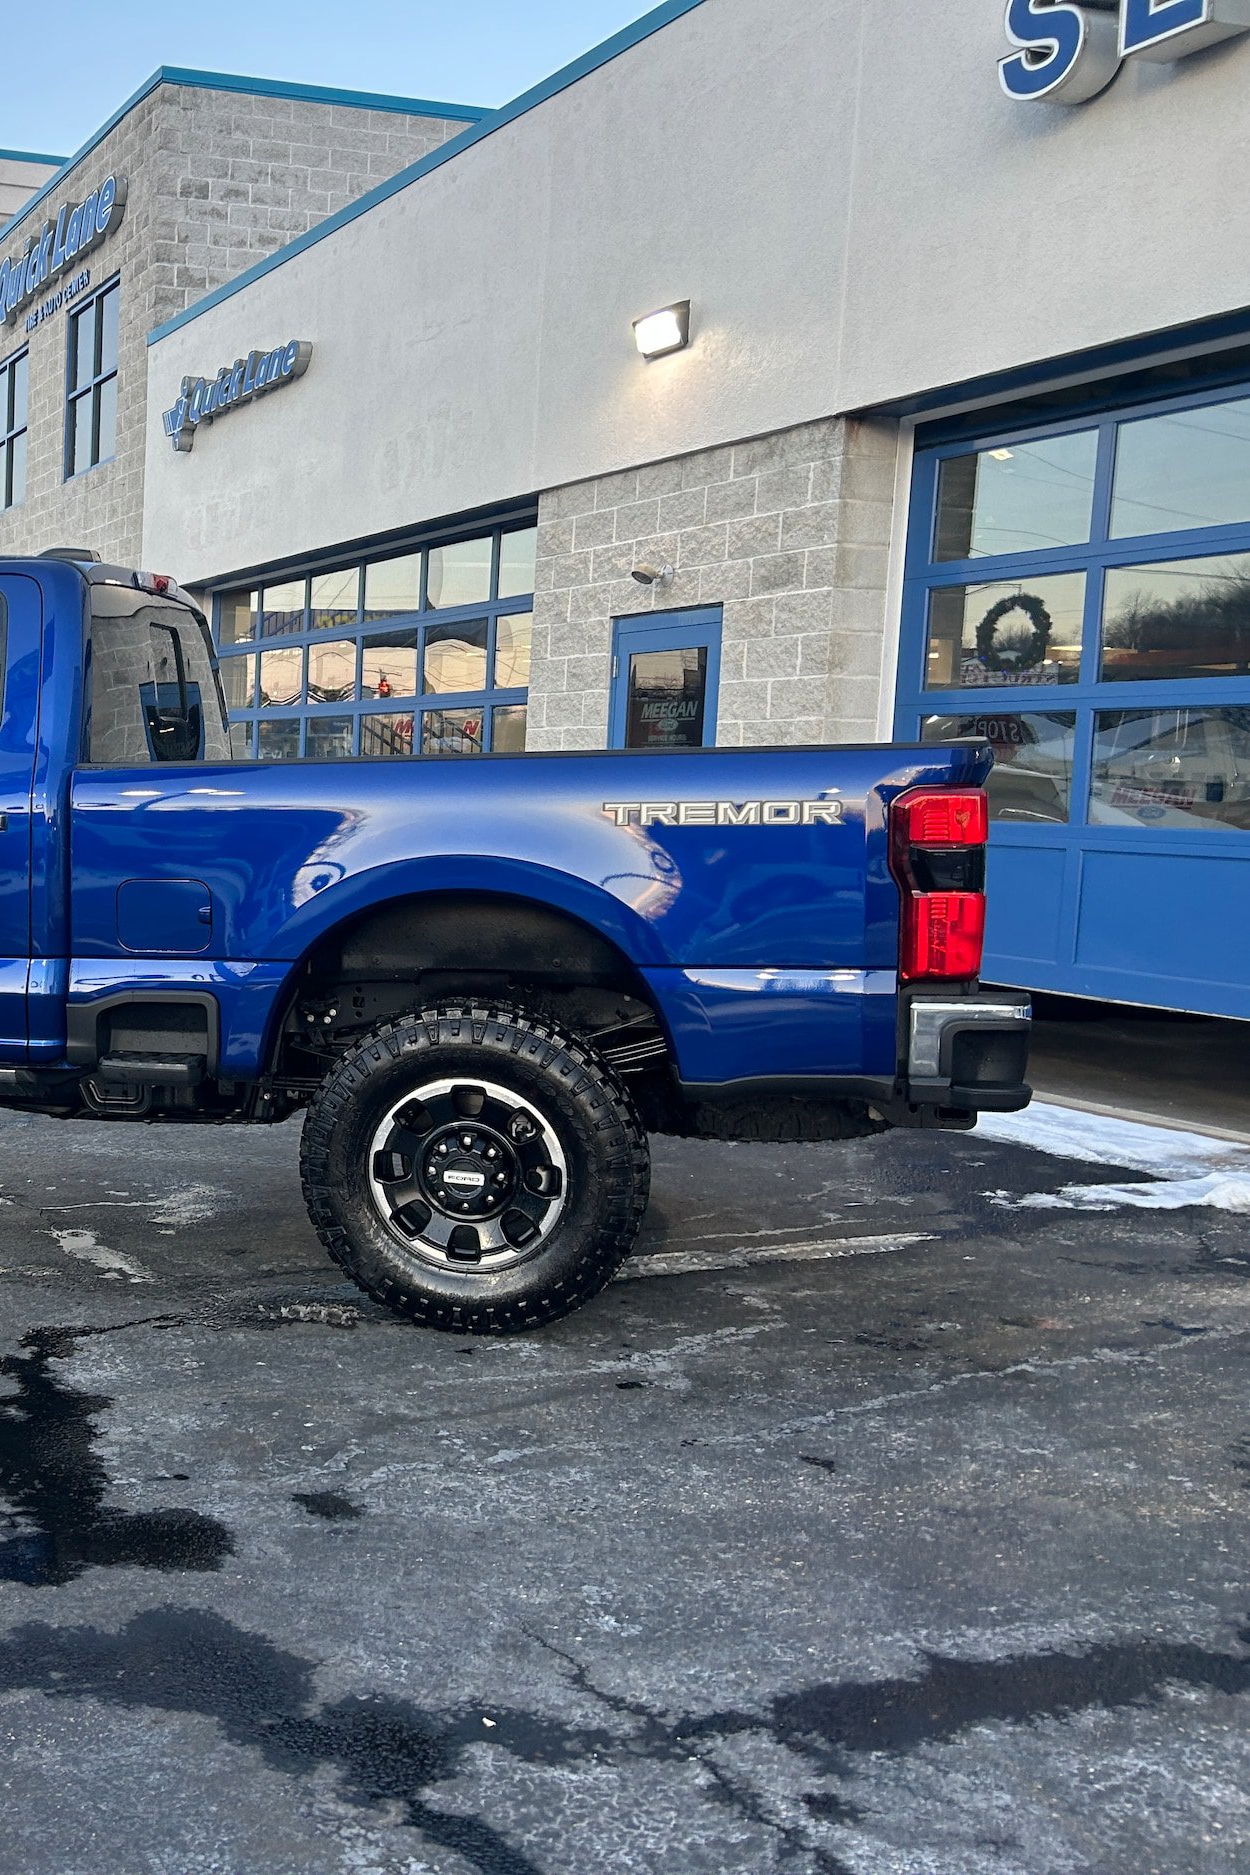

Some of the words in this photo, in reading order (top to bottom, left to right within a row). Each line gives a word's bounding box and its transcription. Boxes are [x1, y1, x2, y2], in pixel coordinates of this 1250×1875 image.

[50, 175, 117, 274] Lane
[189, 359, 245, 425] Quick
[242, 339, 300, 396] Lane
[640, 700, 699, 719] MEEGAN
[603, 799, 846, 827] TREMOR
[447, 1175, 481, 1183] FORD
